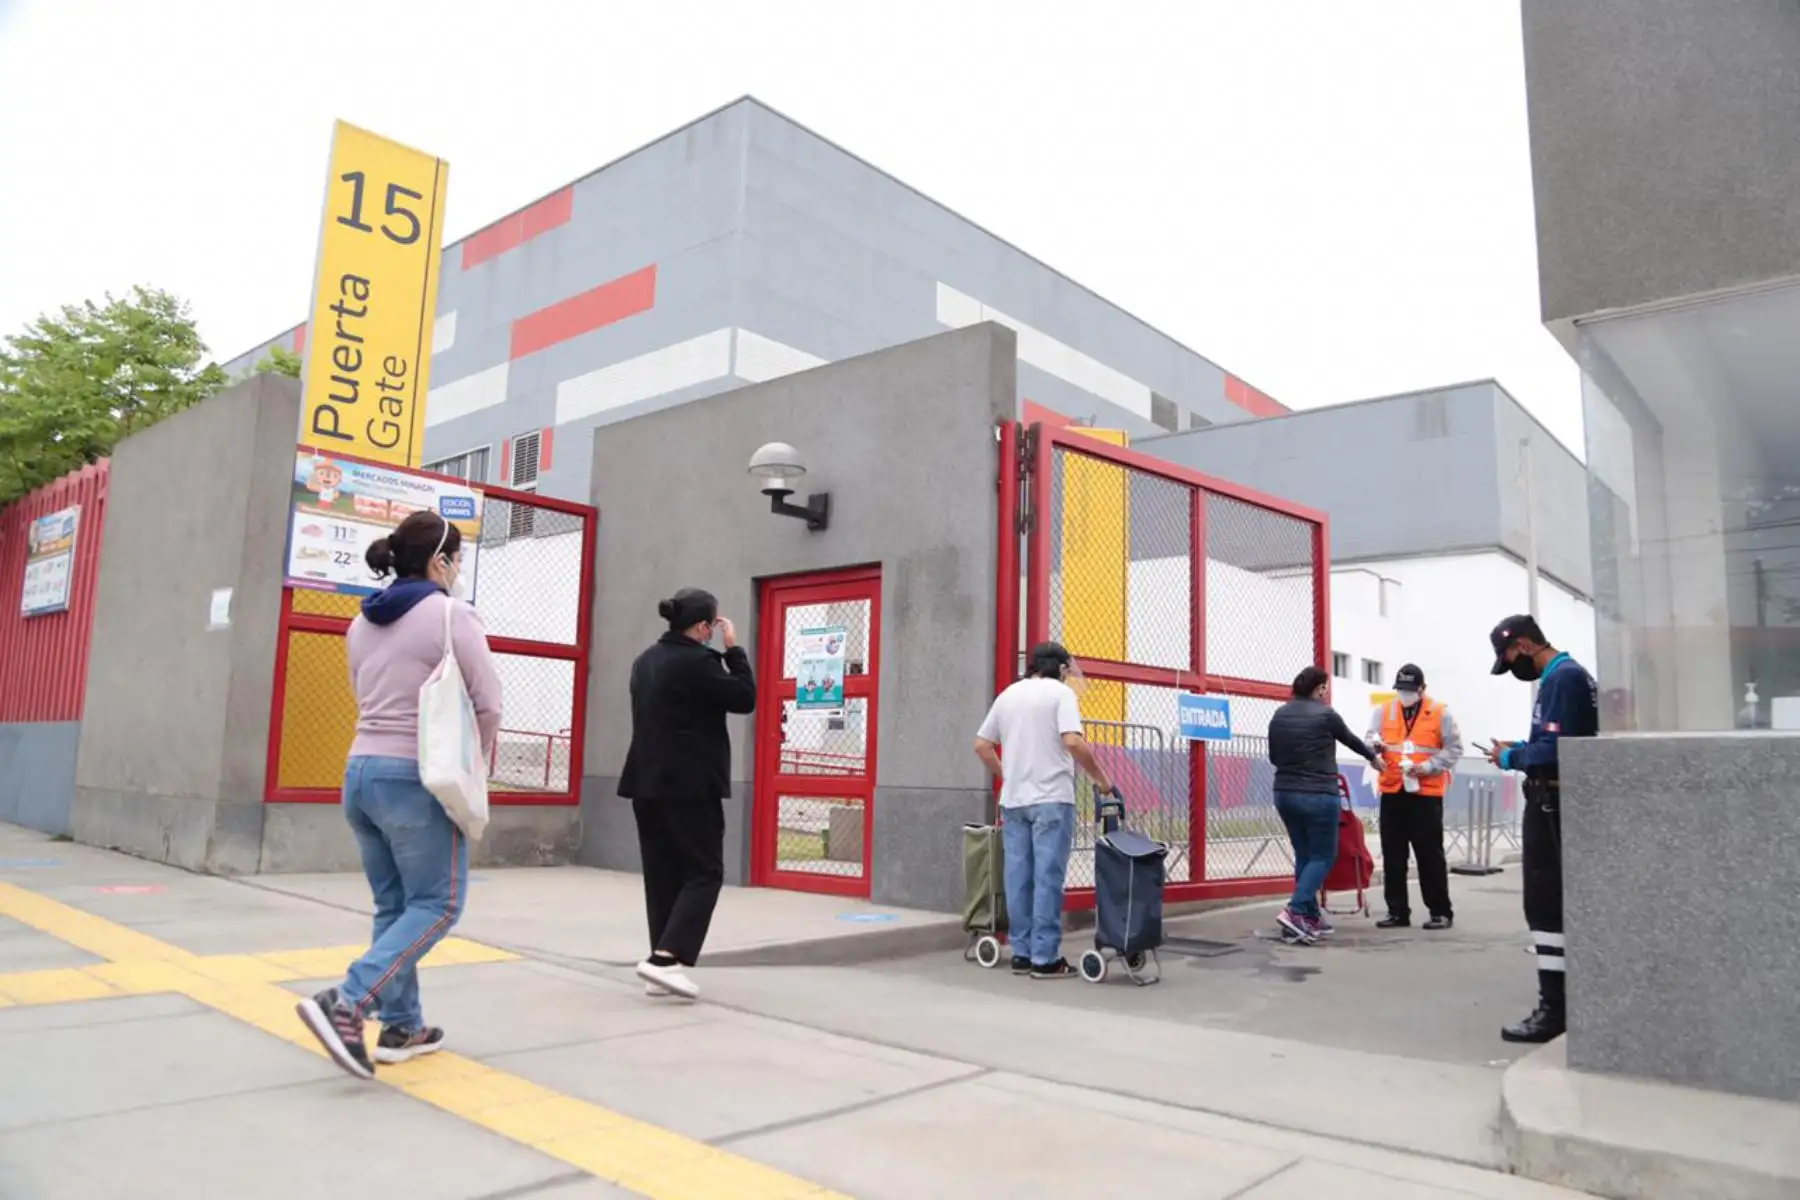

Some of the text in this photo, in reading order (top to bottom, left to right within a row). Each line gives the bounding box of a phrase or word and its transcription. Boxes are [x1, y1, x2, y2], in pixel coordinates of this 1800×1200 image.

[336, 170, 424, 246] 15
[312, 272, 371, 441] Puerta
[366, 354, 408, 449] Gate
[333, 551, 352, 565] 22
[1181, 705, 1228, 729] ENTRADA
